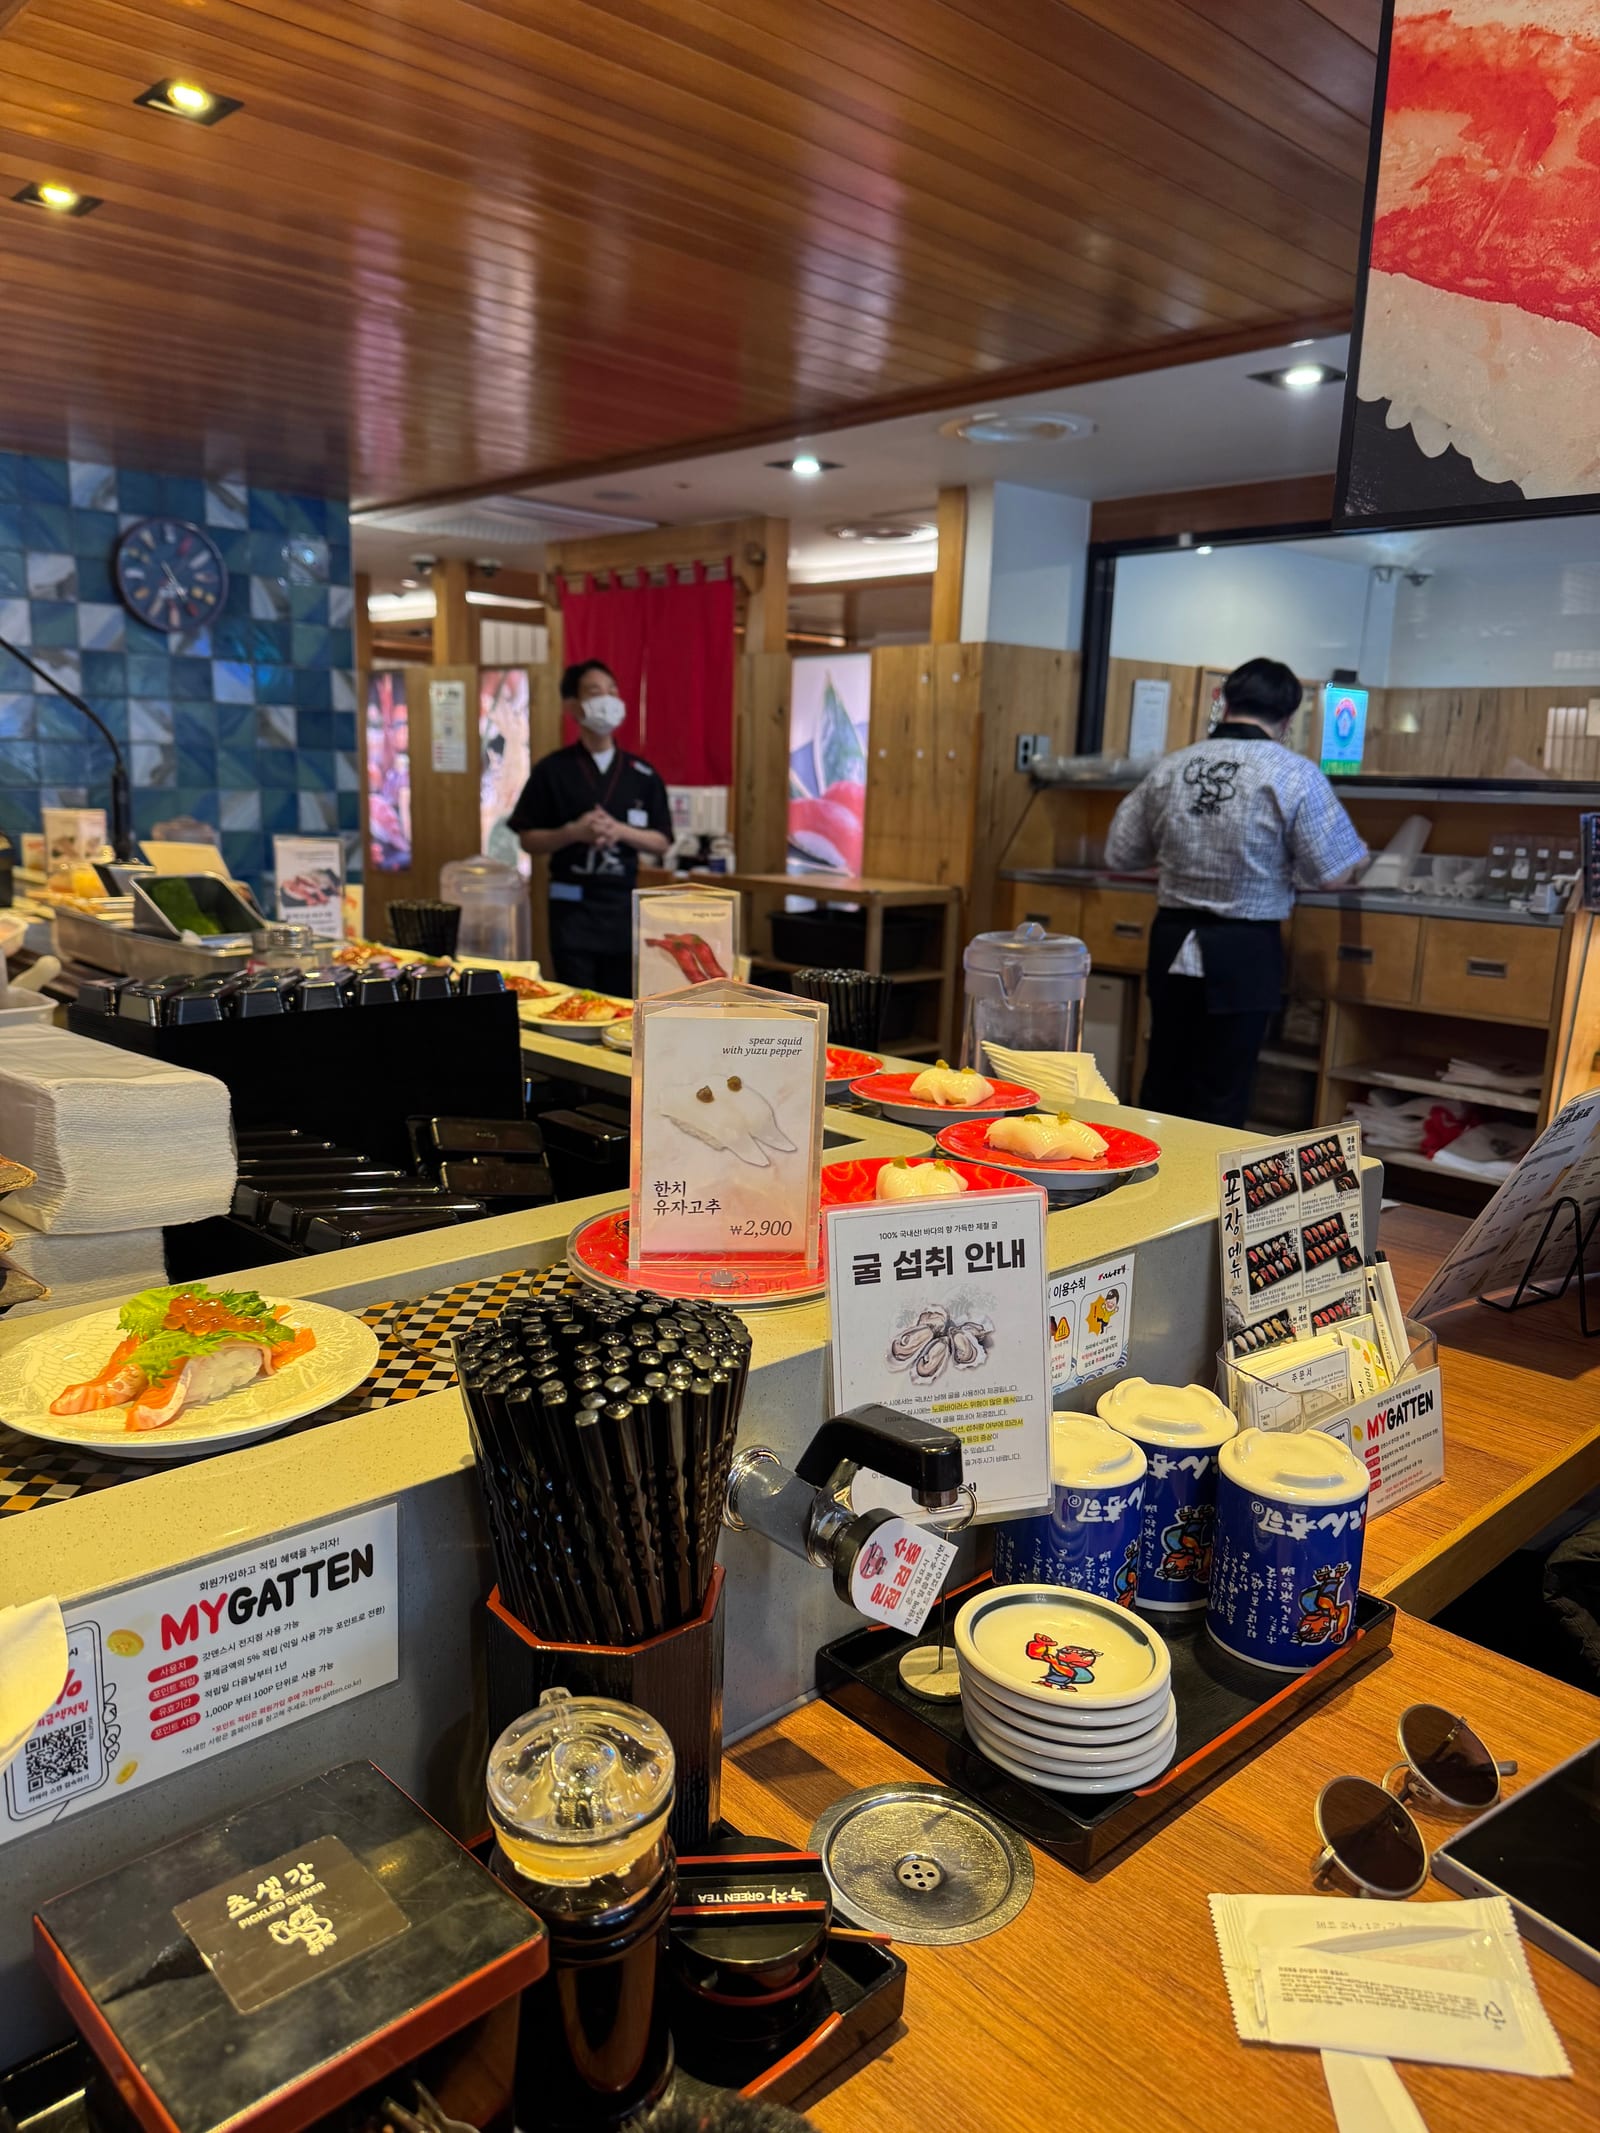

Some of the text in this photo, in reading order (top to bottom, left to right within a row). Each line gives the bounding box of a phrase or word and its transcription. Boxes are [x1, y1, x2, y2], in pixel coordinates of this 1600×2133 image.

[722, 1046, 803, 1058] with yuzu pepper
[749, 1036, 803, 1047] spear squid
[653, 1180, 687, 1199] 한치
[653, 1199, 722, 1217] 유자고추
[729, 1220, 793, 1238] ₩2,900
[879, 1221, 999, 1241] 100% 국내산! 바다의 향 가득한 제철 굴
[1222, 1169, 1243, 1279] 포장 메뉴
[852, 1238, 1026, 1286] 굴 섭취 안내
[1053, 1276, 1086, 1299] 이용수칙
[1291, 1367, 1312, 1383] 주문서
[1366, 1389, 1434, 1441] MYGATTEN
[198, 1537, 341, 1592] 회원가입하고 적립 혜택을 누리자!
[160, 1543, 374, 1651] MYGATTEN
[202, 1641, 236, 1662] 갓덴스시
[238, 1632, 263, 1648] 전지점
[265, 1625, 281, 1638] 사용
[283, 1620, 300, 1631] 가능
[203, 1657, 245, 1681] 결제금액의
[246, 1652, 261, 1664] 5%
[262, 1645, 278, 1657] 적립
[279, 1638, 299, 1653] (익일
[300, 1631, 316, 1643] 사용
[318, 1625, 334, 1637] 가능
[335, 1612, 366, 1630] 포인트로
[367, 1605, 385, 1618] 전환)
[204, 1682, 230, 1699] 적립일
[232, 1666, 273, 1688] 다음날부터
[274, 1660, 288, 1670] 1년
[205, 1700, 233, 1718] 1,000P
[234, 1693, 252, 1705] 부터
[253, 1685, 274, 1699] 100P
[275, 1675, 299, 1691] 단위로
[300, 1667, 317, 1680] 사용
[318, 1662, 334, 1673] 가능
[238, 1881, 327, 1930] PICKLED GINGER
[698, 1886, 808, 1905] 녹차 GREEN TEA
